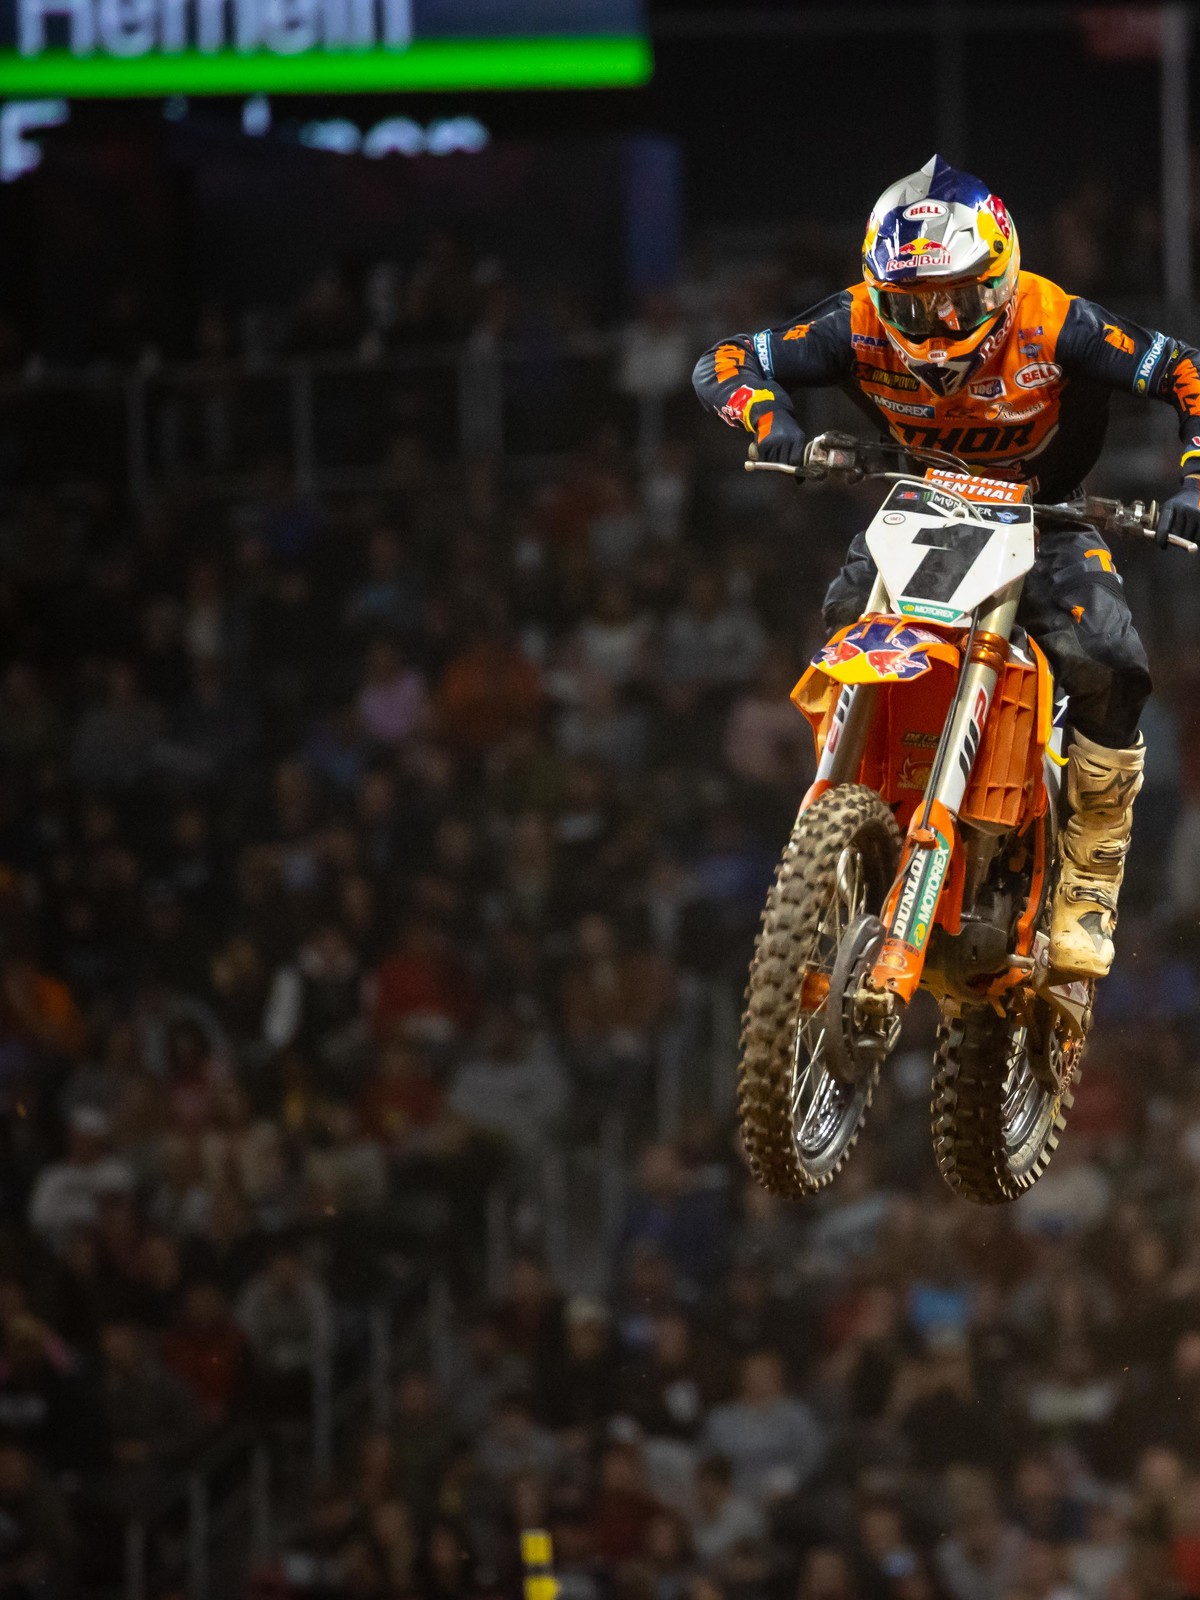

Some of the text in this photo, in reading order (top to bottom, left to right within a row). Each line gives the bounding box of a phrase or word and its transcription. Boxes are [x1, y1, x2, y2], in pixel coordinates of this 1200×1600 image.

[909, 205, 941, 217] BELL
[886, 254, 951, 273] Red Bull
[1021, 366, 1056, 384] BELL
[874, 395, 929, 418] MOTOREX
[896, 421, 1036, 454] THOR
[901, 523, 996, 603] 1
[914, 605, 954, 619] MOTOREX
[918, 848, 949, 924] MOTOREX
